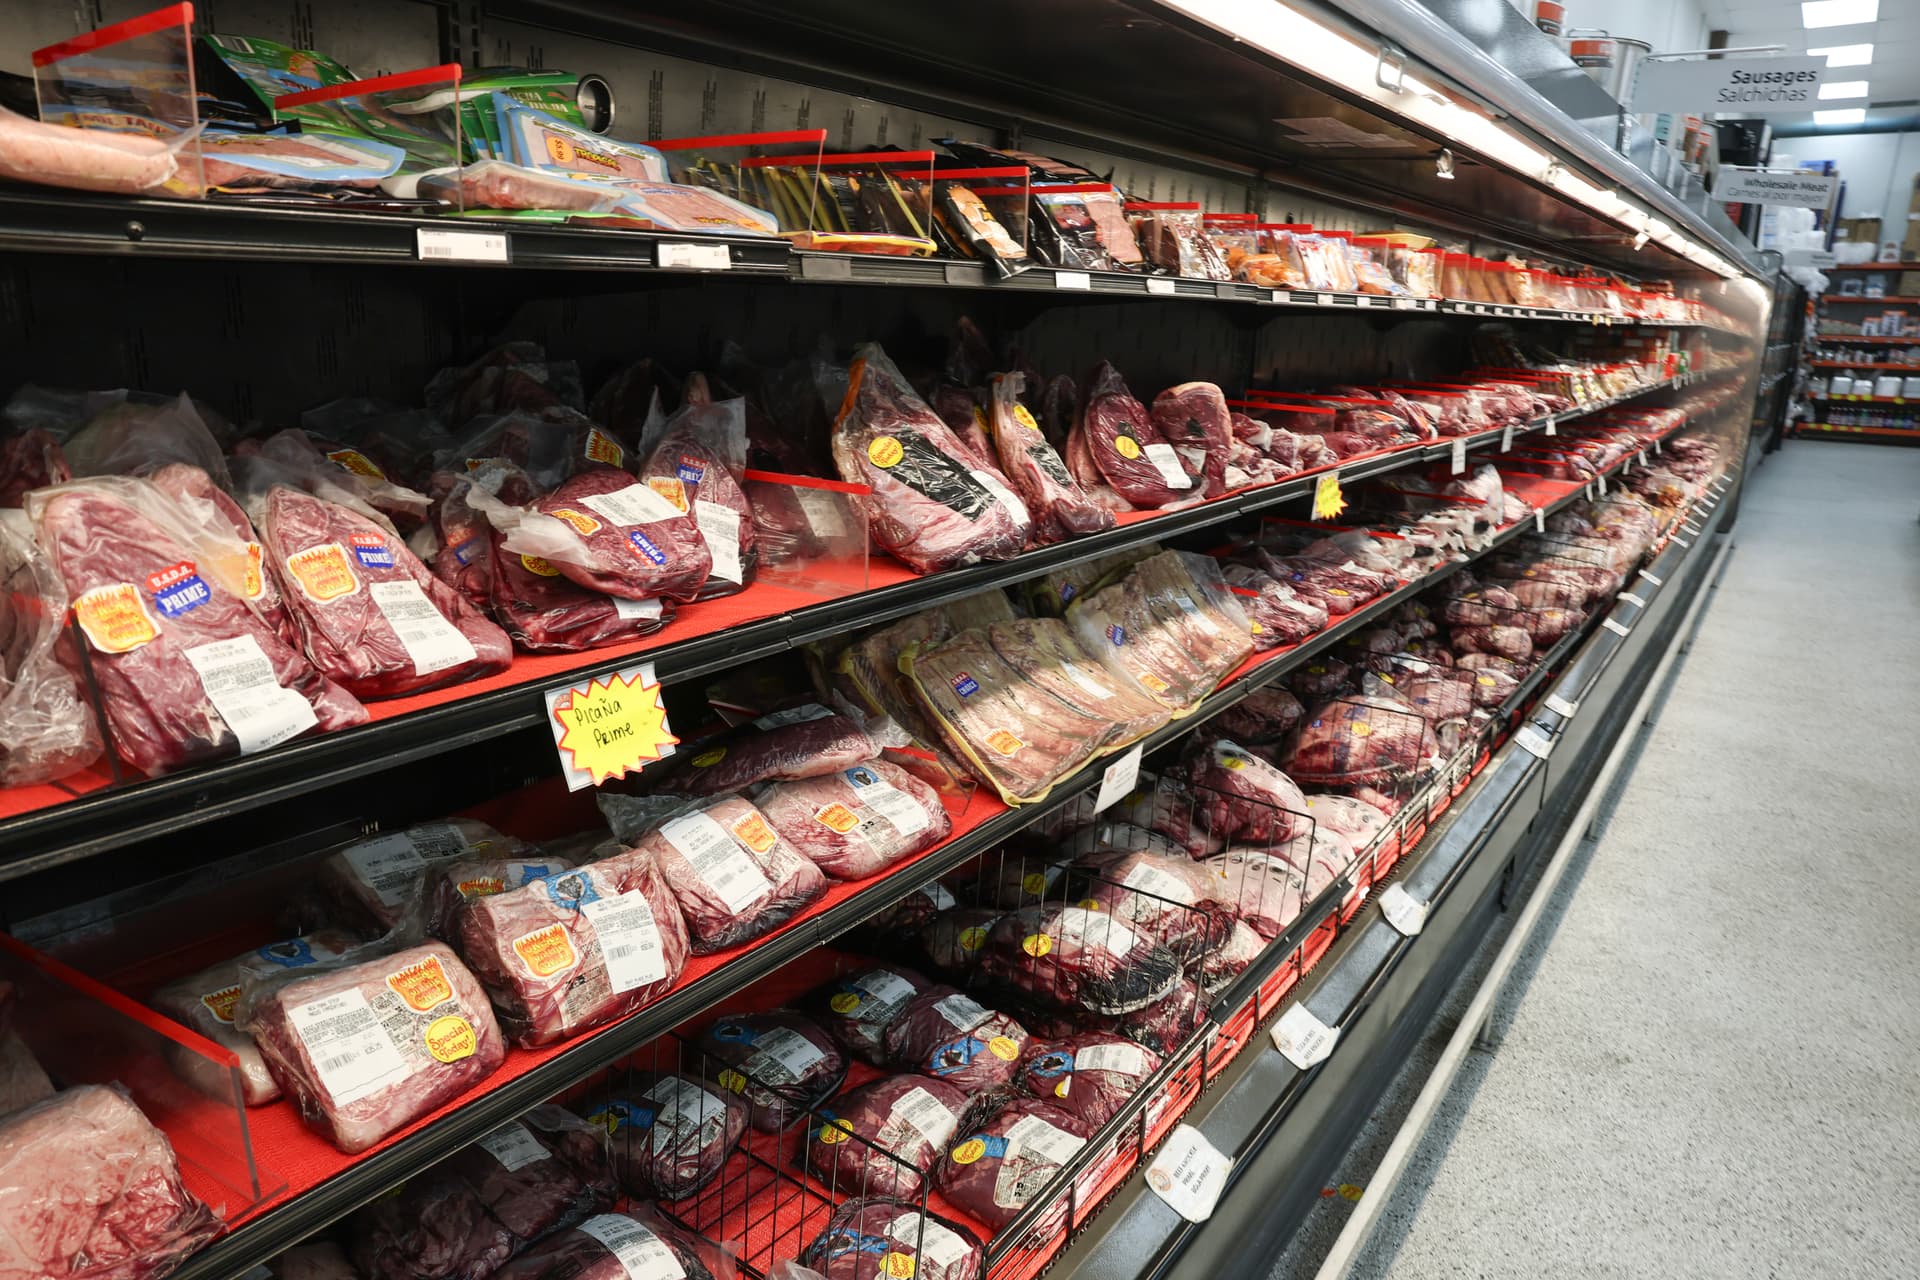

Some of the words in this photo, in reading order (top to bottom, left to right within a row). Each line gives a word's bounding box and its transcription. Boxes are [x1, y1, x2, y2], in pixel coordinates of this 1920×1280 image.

[1730, 69, 1817, 86] Sausages
[1717, 87, 1808, 103] Salchichas
[359, 551, 394, 564] PRIME
[151, 564, 193, 587] U.S.D.A.
[161, 582, 209, 614] PRIME
[428, 1021, 468, 1051] Special
[439, 1035, 472, 1059] Today!
